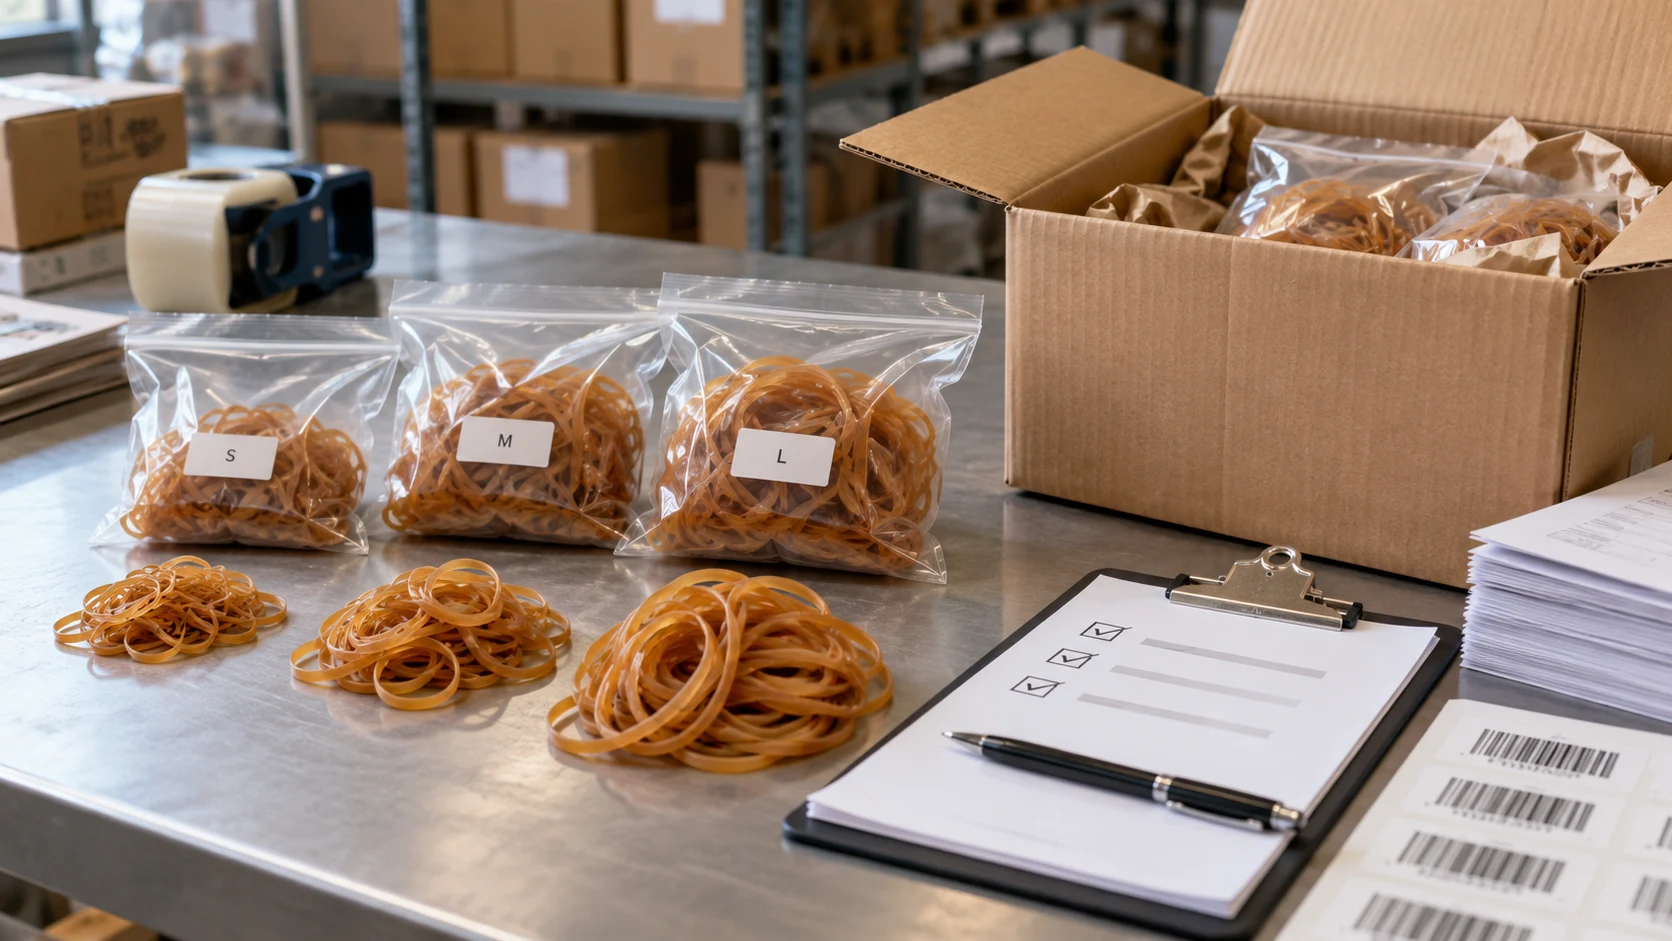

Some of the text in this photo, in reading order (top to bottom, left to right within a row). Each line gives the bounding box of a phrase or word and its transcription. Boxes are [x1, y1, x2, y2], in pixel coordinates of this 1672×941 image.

[498, 433, 513, 448] M
[225, 449, 236, 462] S
[776, 449, 787, 465] L
